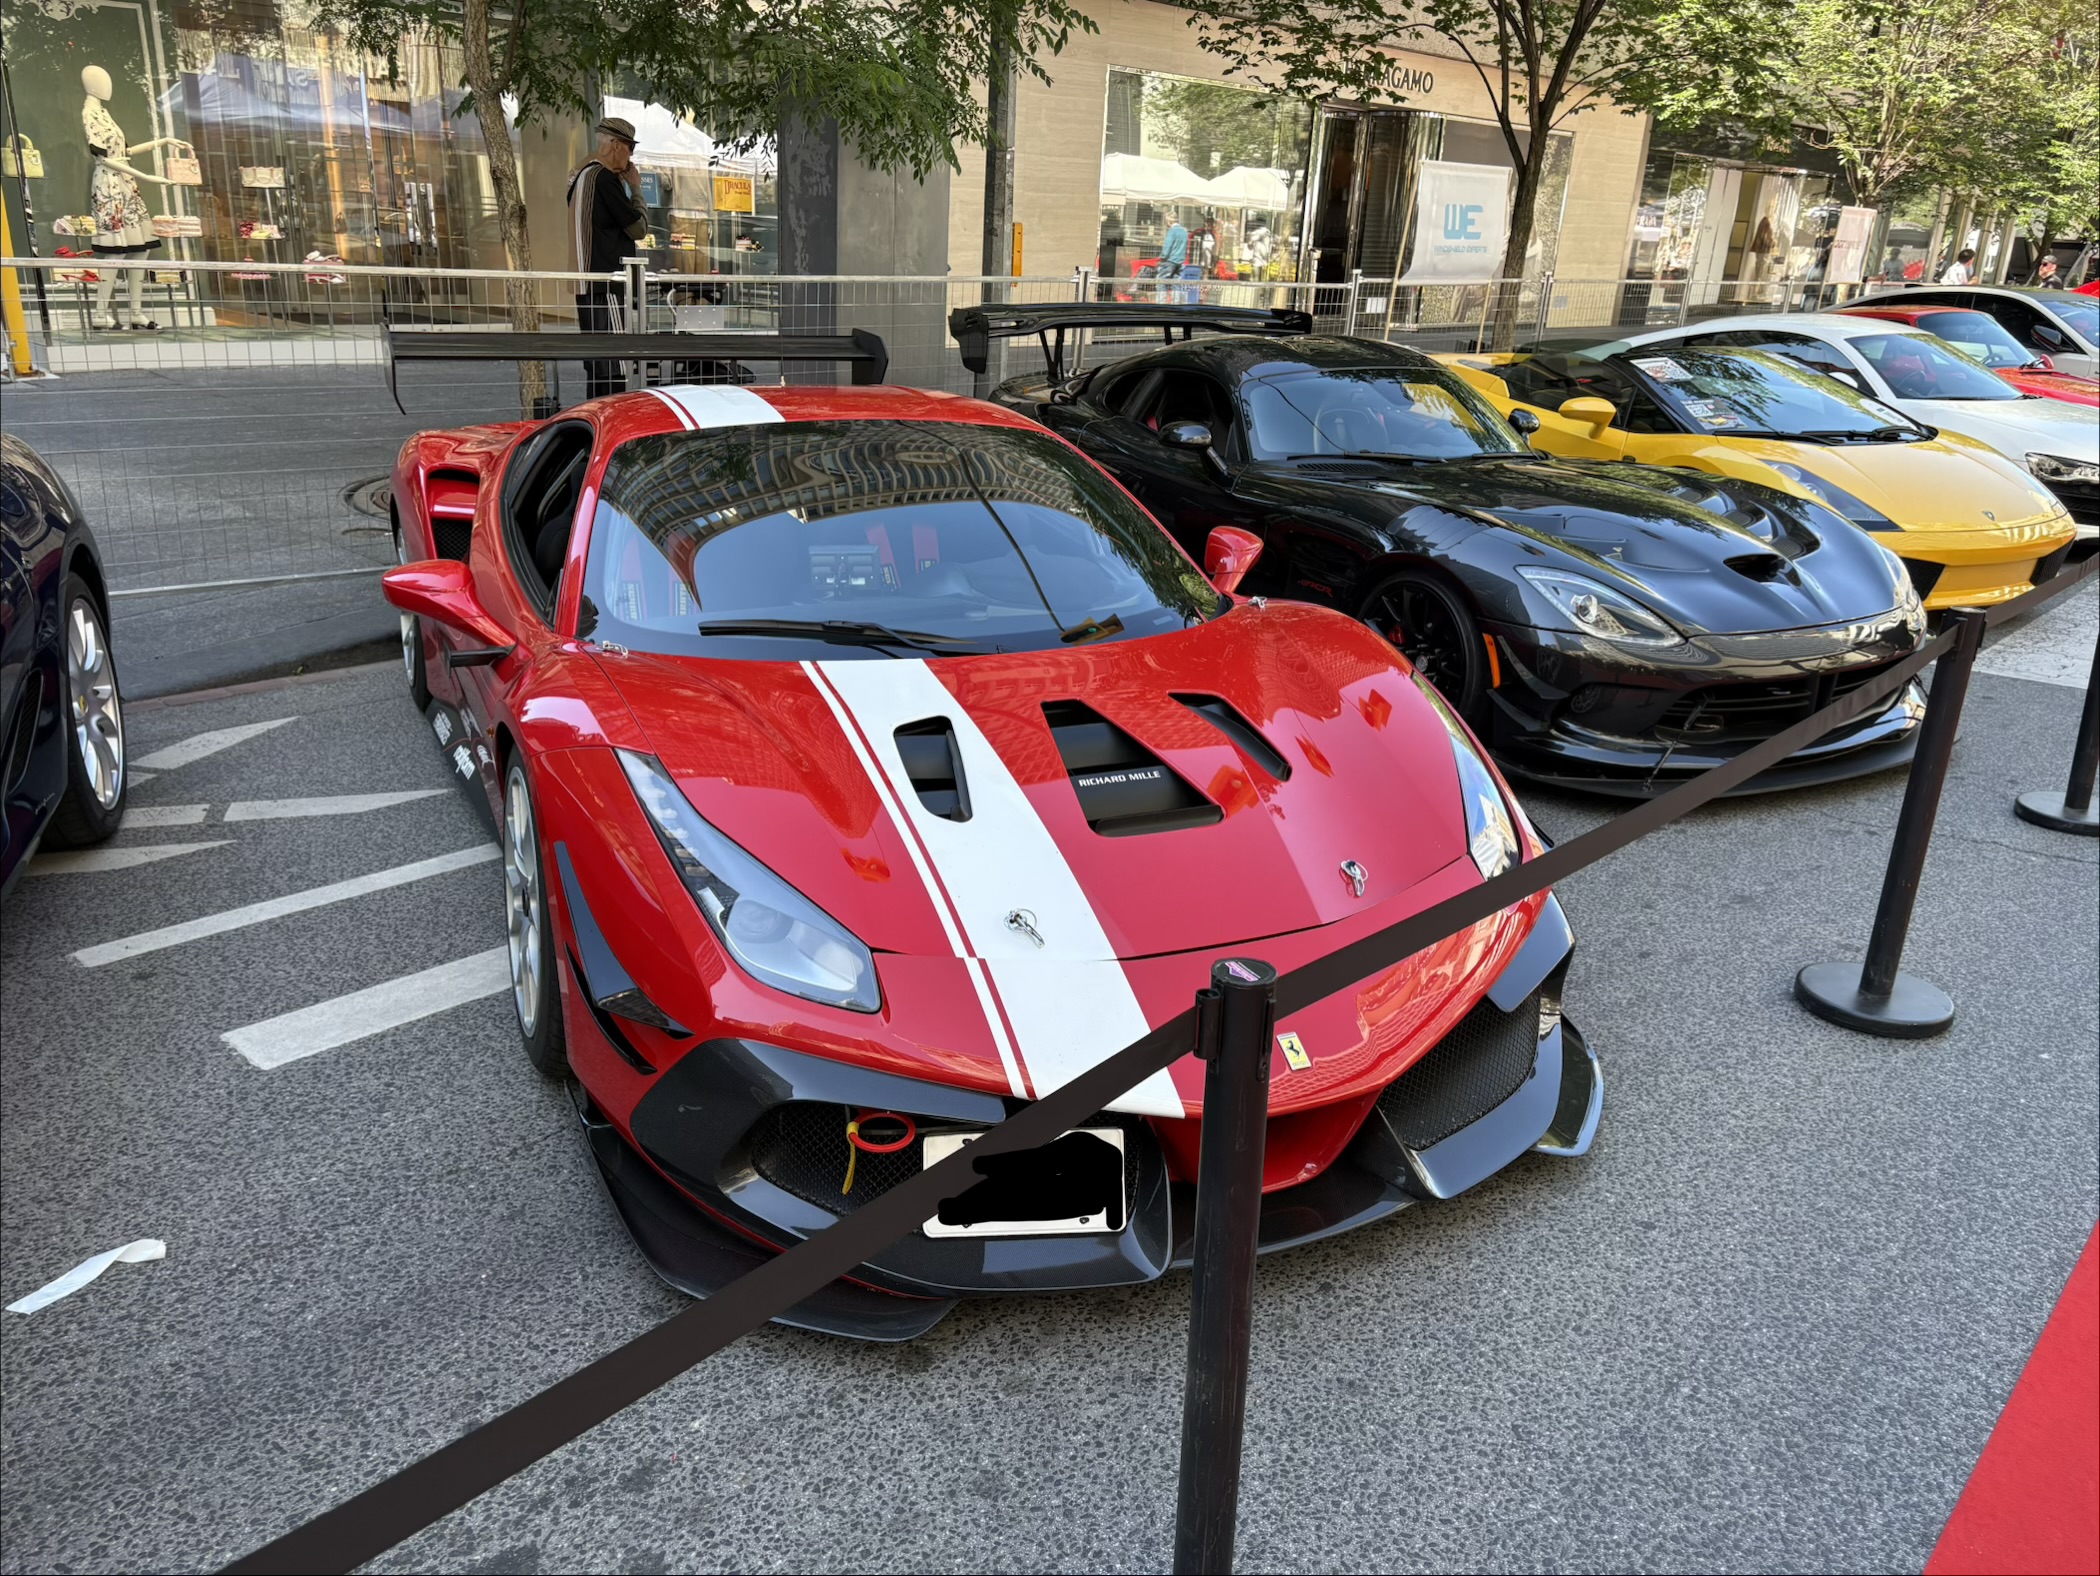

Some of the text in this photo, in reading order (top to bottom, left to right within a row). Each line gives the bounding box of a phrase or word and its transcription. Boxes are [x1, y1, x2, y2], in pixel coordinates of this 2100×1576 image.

[724, 178, 752, 195] DRACULA
[1443, 203, 1484, 241] WE
[1078, 770, 1161, 787] RICHARD MILLE
